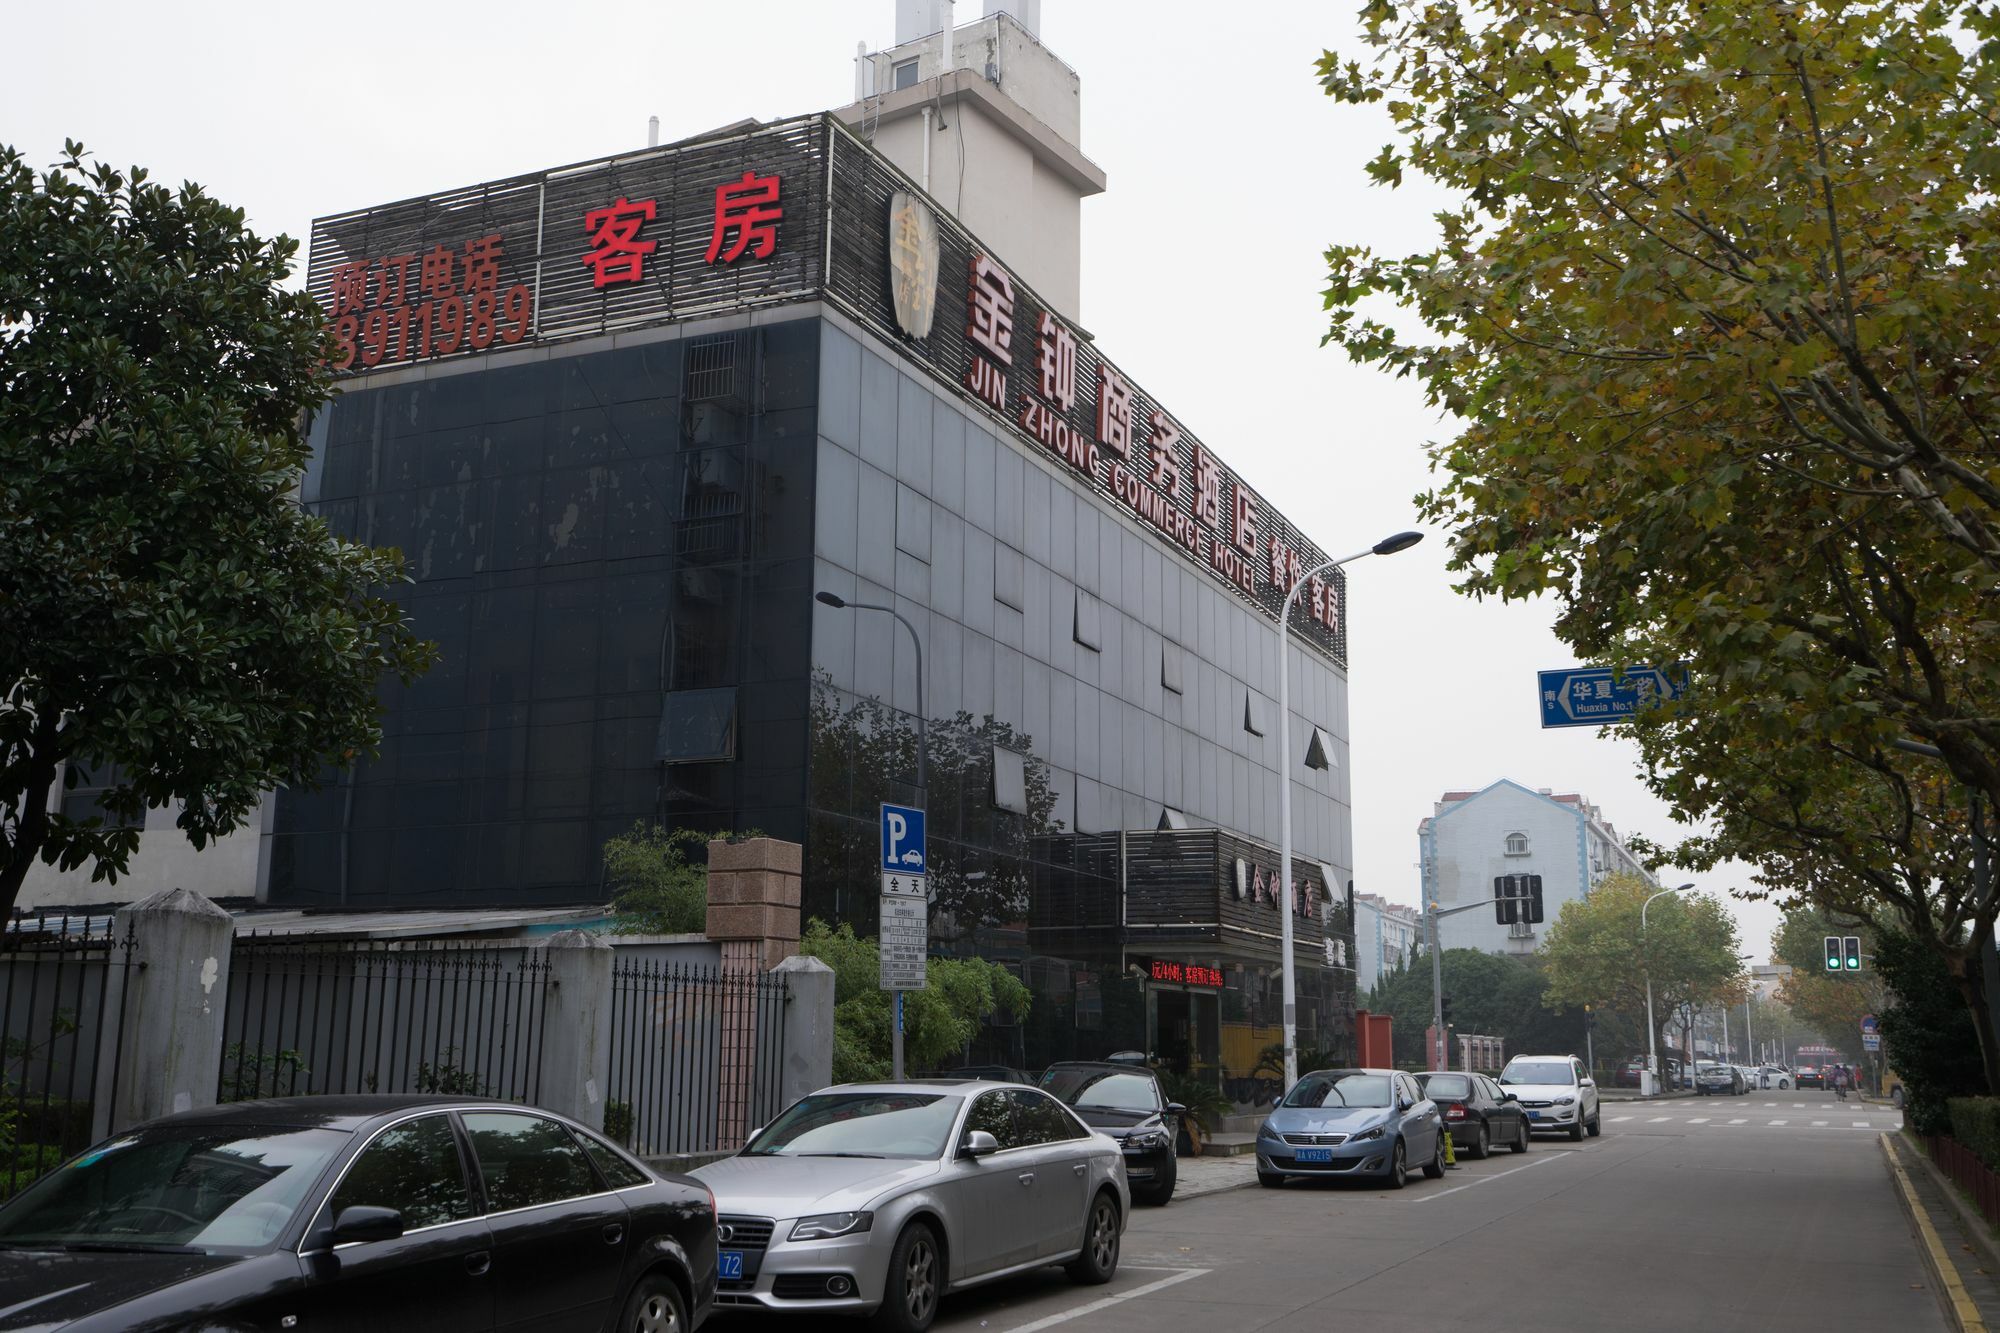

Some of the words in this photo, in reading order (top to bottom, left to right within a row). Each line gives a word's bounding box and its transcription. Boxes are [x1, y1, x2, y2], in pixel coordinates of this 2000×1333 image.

[581, 170, 784, 289] 客房
[328, 233, 503, 317] 预订电话
[307, 284, 531, 374] 8911989
[968, 254, 1258, 558] 金钟商务酒店
[1310, 572, 1339, 634] 客房
[969, 355, 1007, 411] JIN
[1022, 395, 1100, 478] ZHONG
[1112, 463, 1204, 557] COMMERCE
[1213, 540, 1258, 596] HOTEL
[1543, 690, 1556, 702] 南
[1547, 702, 1554, 710] S
[1576, 702, 1609, 713] Huaxia
[1612, 701, 1633, 712] No.1
[887, 812, 908, 865] P
[890, 876, 920, 894] 全天
[723, 1255, 741, 1275] 72
